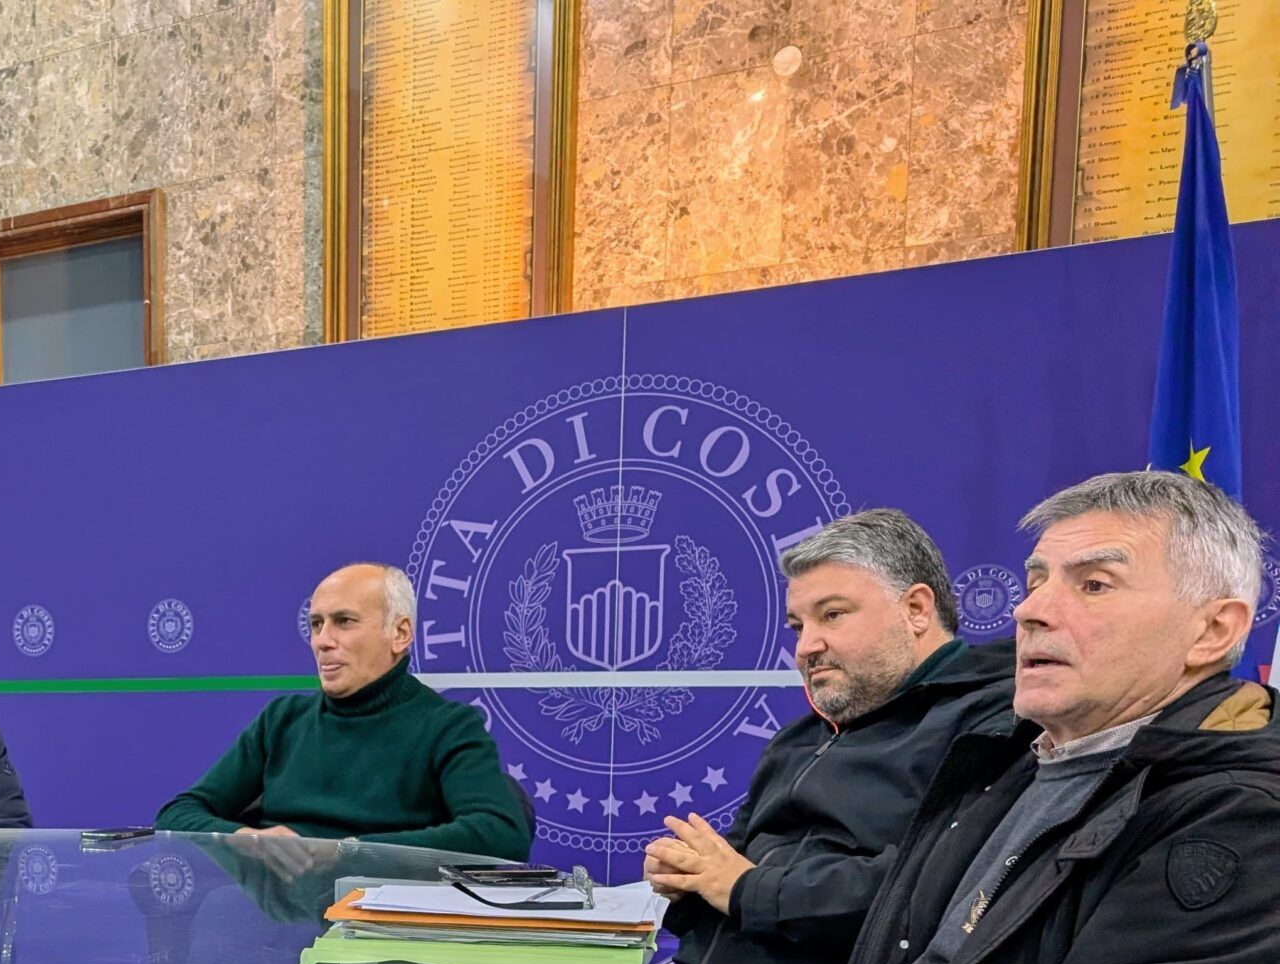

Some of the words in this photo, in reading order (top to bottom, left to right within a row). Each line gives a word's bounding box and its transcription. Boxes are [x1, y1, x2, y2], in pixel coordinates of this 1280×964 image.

[424, 519, 498, 733] TTÀ
[503, 411, 597, 494] DI
[641, 405, 824, 742] COSA
